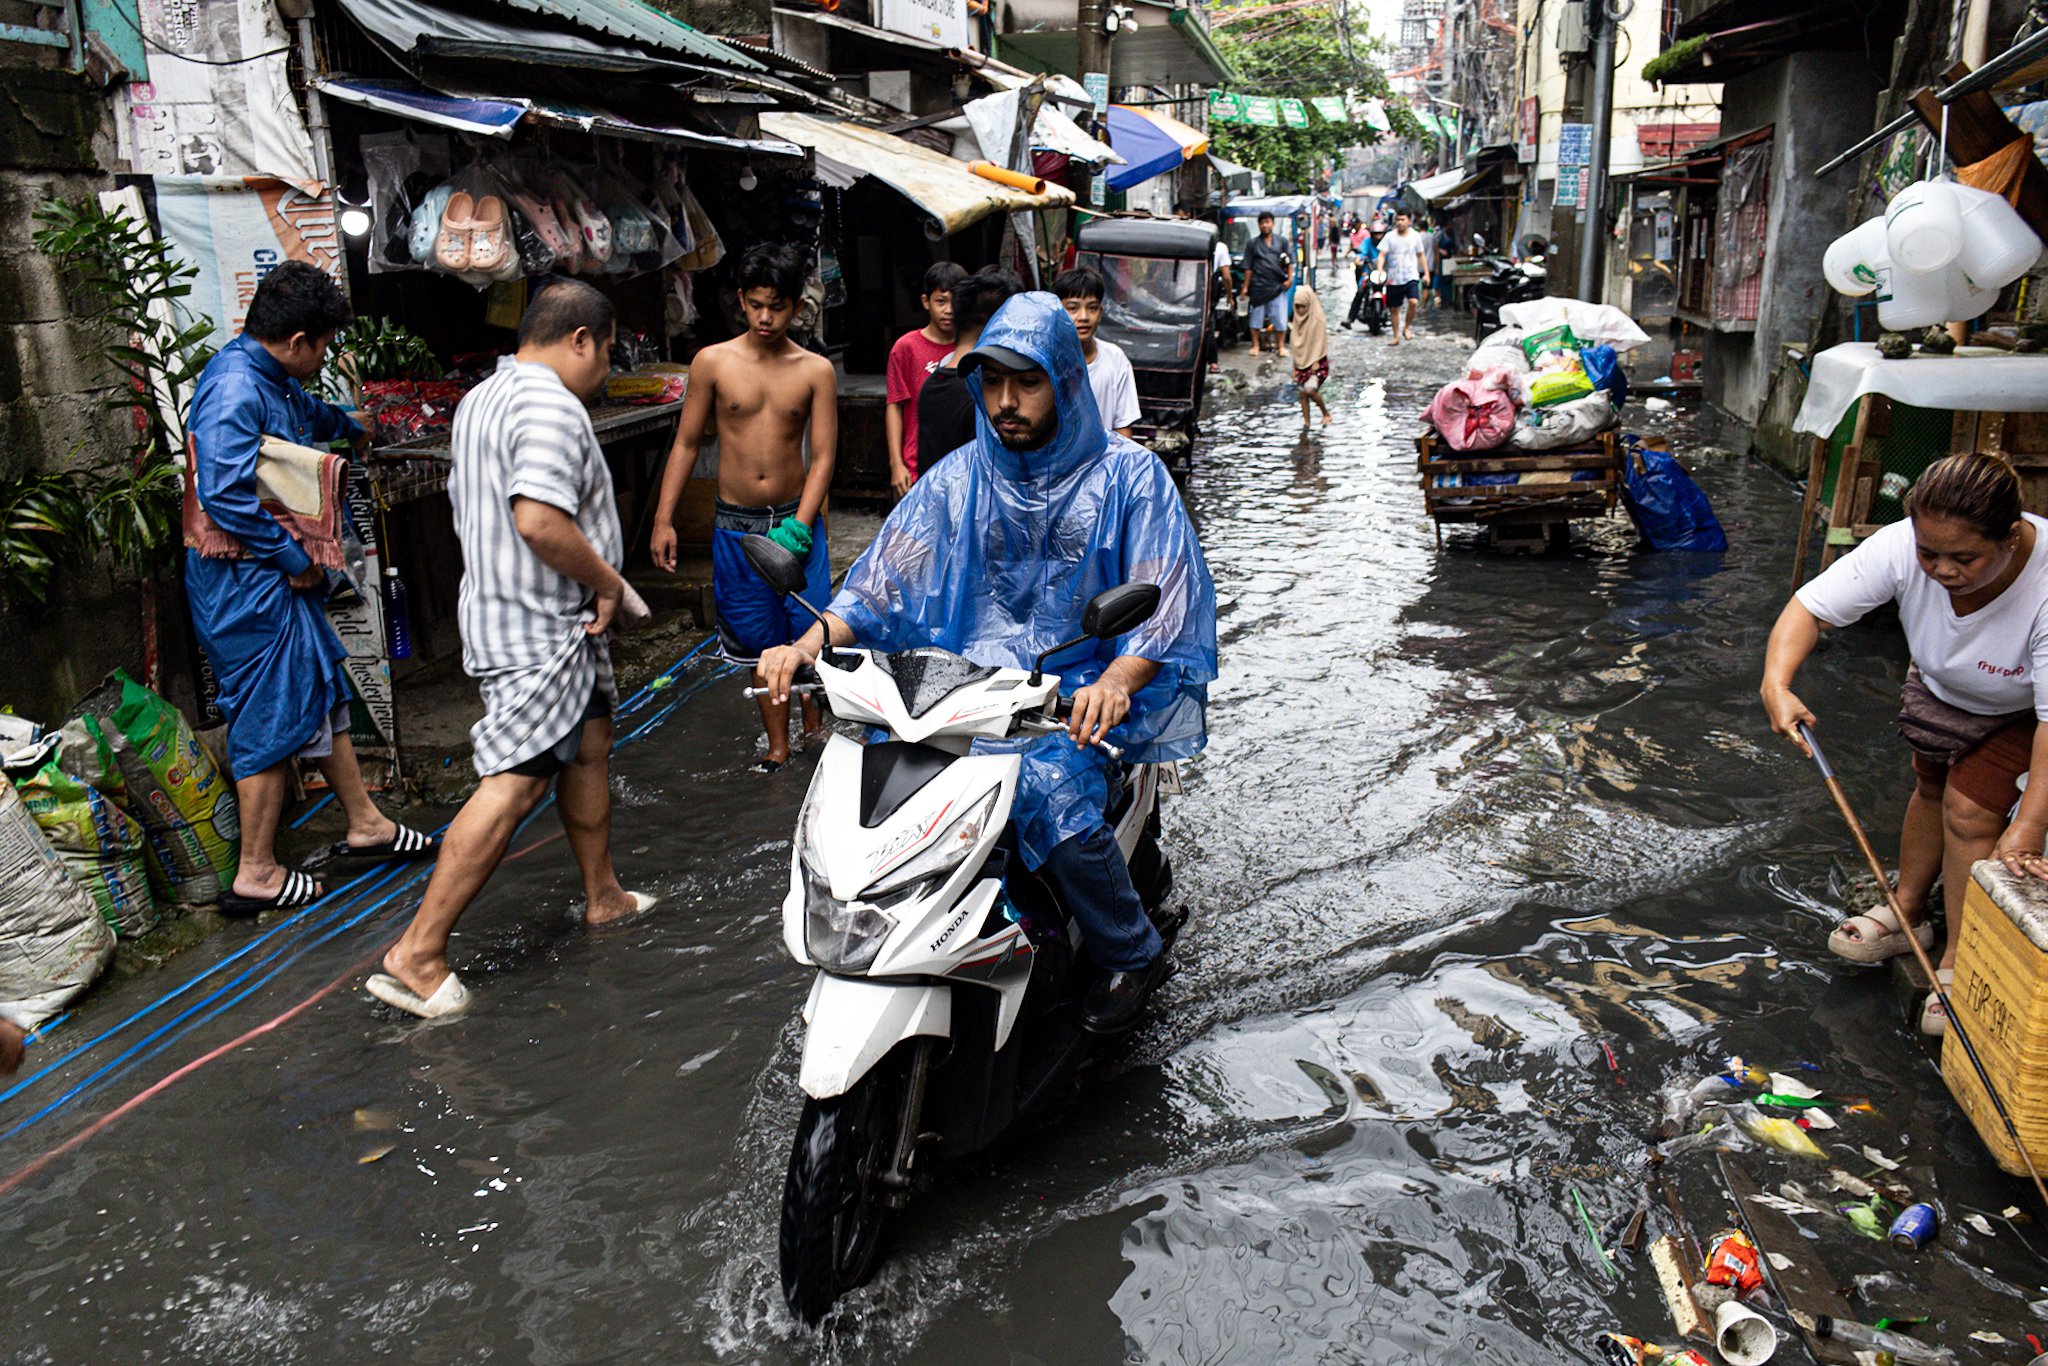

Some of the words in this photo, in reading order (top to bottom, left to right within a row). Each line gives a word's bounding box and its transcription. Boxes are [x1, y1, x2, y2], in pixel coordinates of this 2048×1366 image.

[171, 0, 191, 49] DESIGN
[915, 651, 950, 660] HONDA
[930, 910, 969, 952] HONDA
[1967, 968, 1992, 1024] FOR
